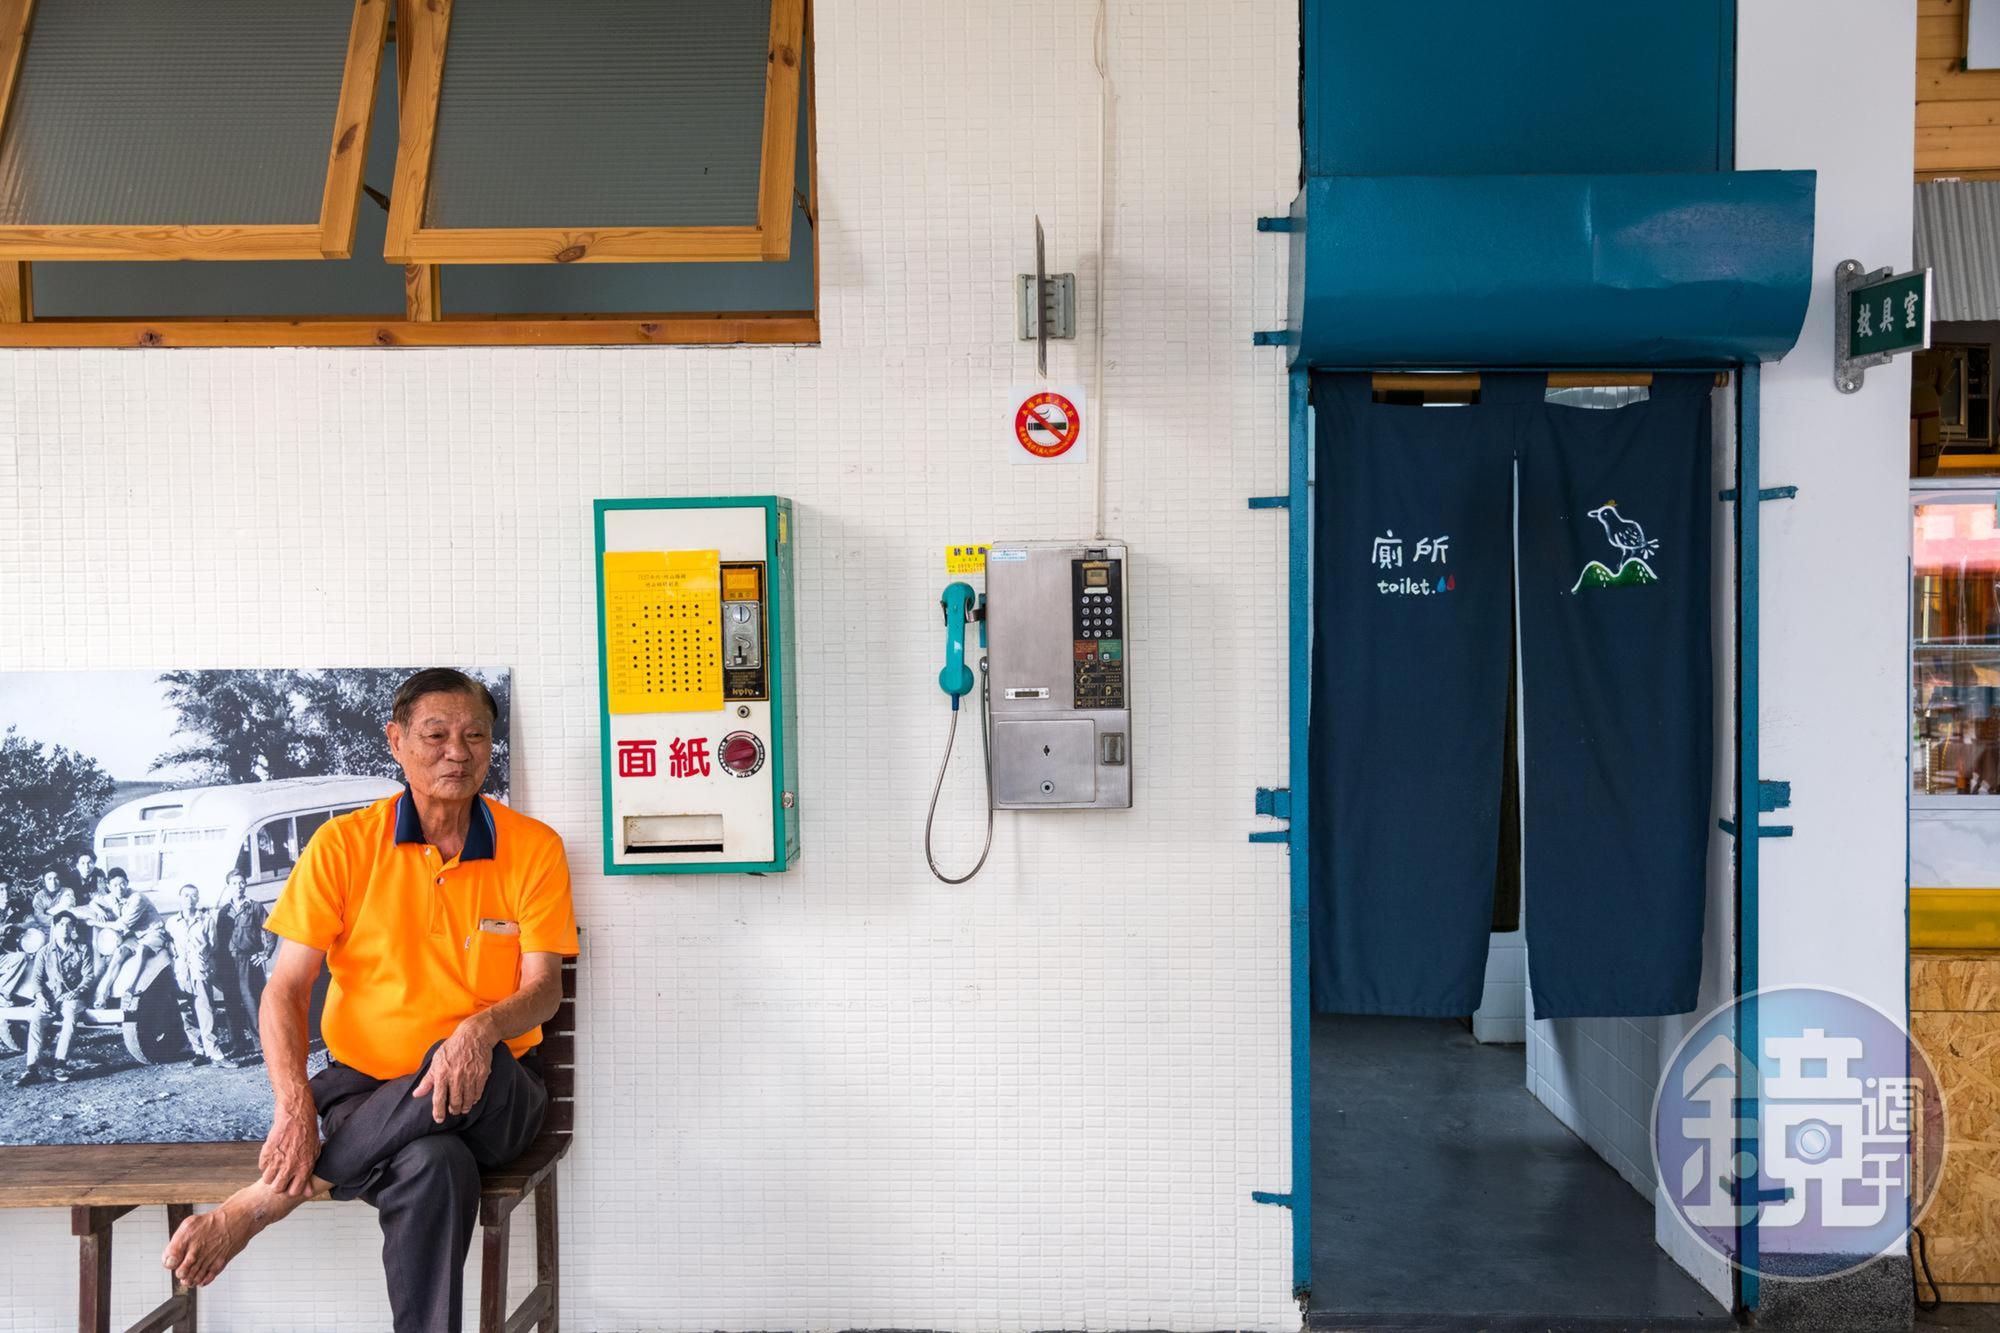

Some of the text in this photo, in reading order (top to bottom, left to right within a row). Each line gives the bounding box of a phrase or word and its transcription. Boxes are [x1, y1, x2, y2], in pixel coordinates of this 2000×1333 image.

[1856, 290, 1919, 338] 教具室
[1371, 529, 1449, 569] 廁所
[1376, 576, 1436, 595] toilet.
[617, 737, 710, 778] 面紙
